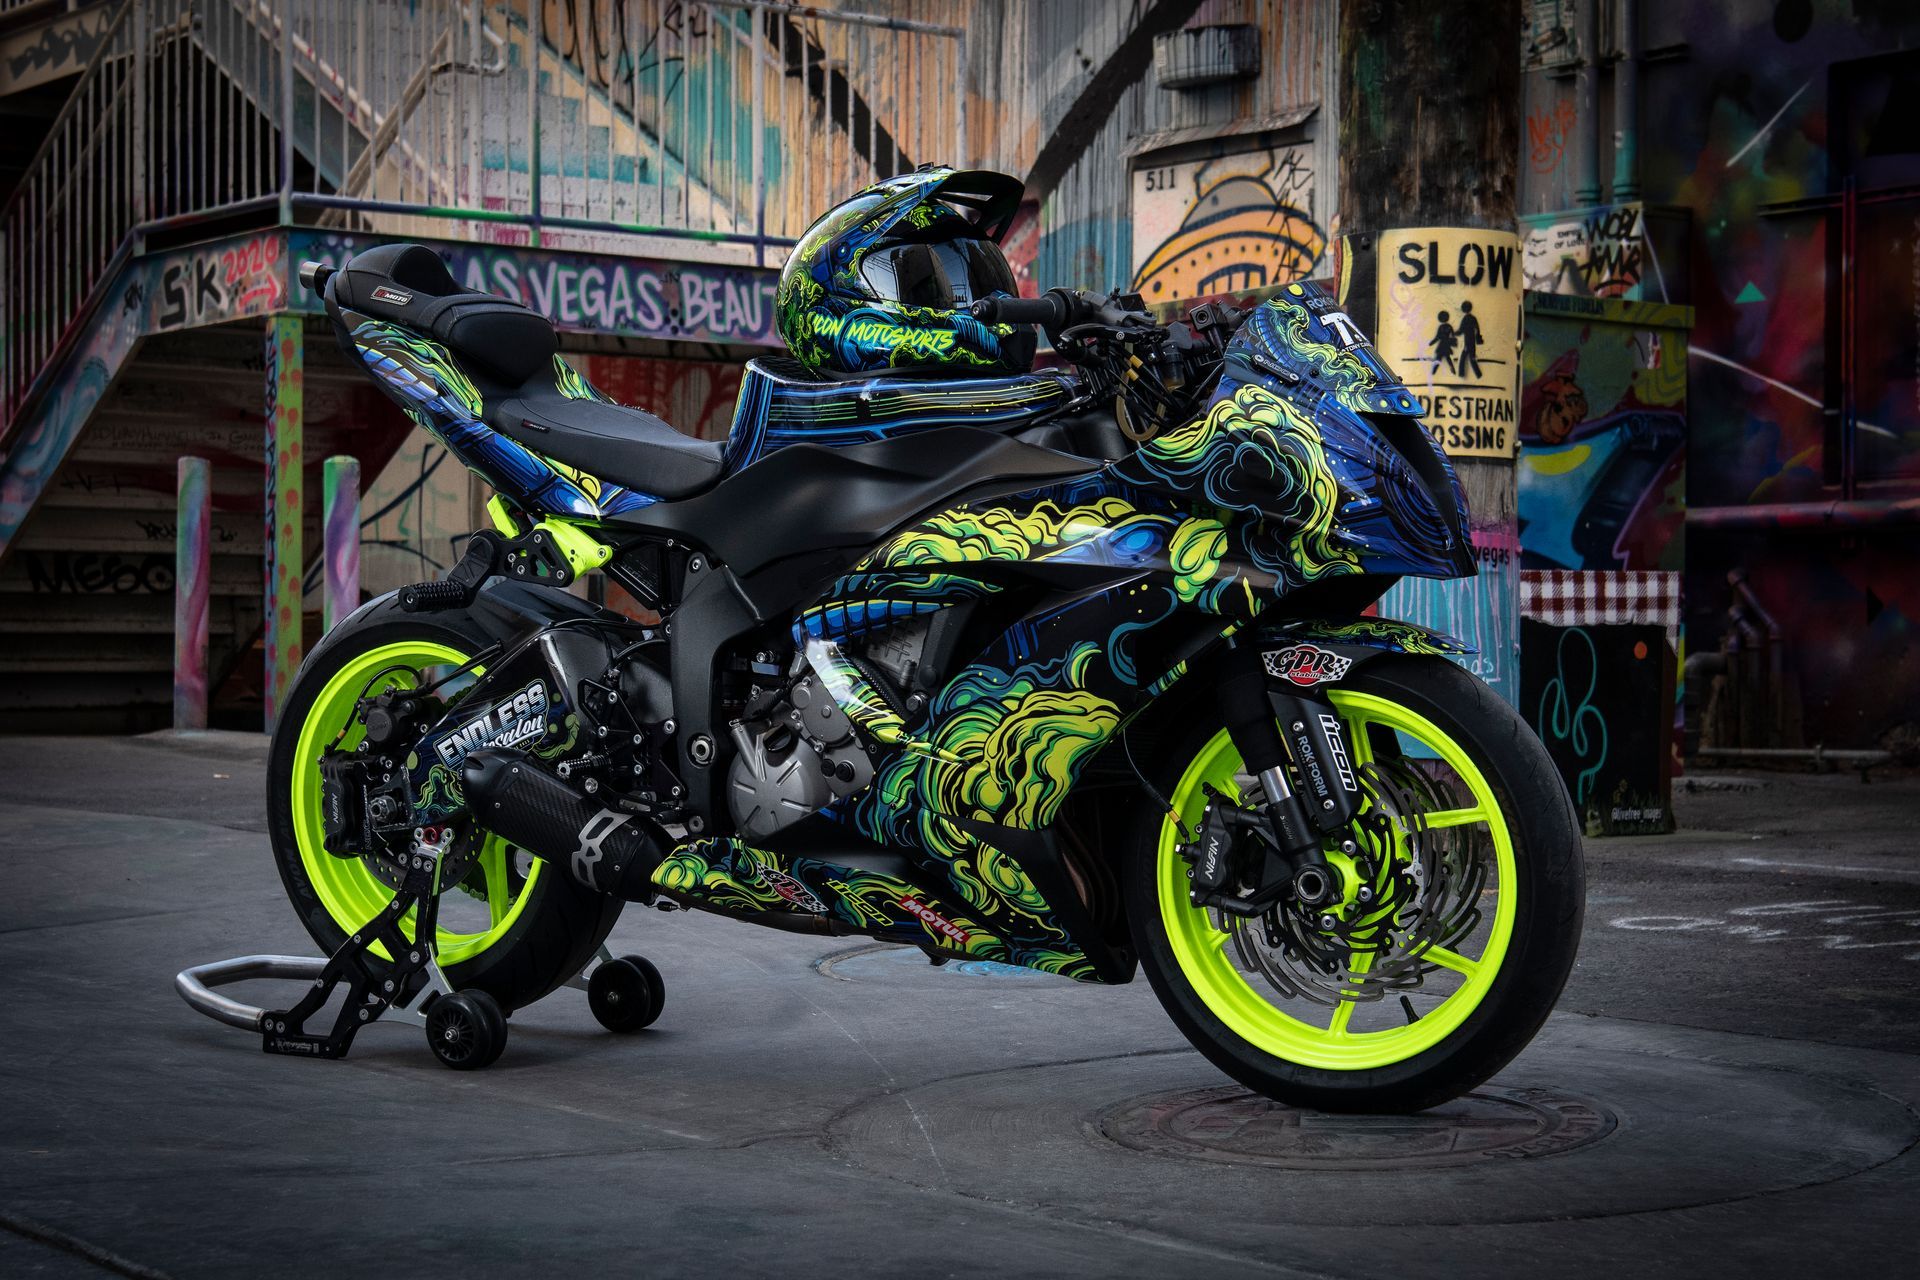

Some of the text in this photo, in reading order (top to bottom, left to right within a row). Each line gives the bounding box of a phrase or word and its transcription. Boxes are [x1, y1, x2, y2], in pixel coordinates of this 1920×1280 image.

[1146, 168, 1175, 192] 511
[223, 236, 279, 284] 2020
[1398, 241, 1513, 289] SLOW
[528, 262, 664, 332] VEGAS
[847, 322, 953, 352] MOTOSPORTS
[1417, 396, 1514, 422] DESTRIAN
[1424, 425, 1505, 449] OSSING
[1273, 649, 1335, 675] GPR
[437, 684, 546, 766] ENDLESS
[902, 899, 967, 942] MOTUL
